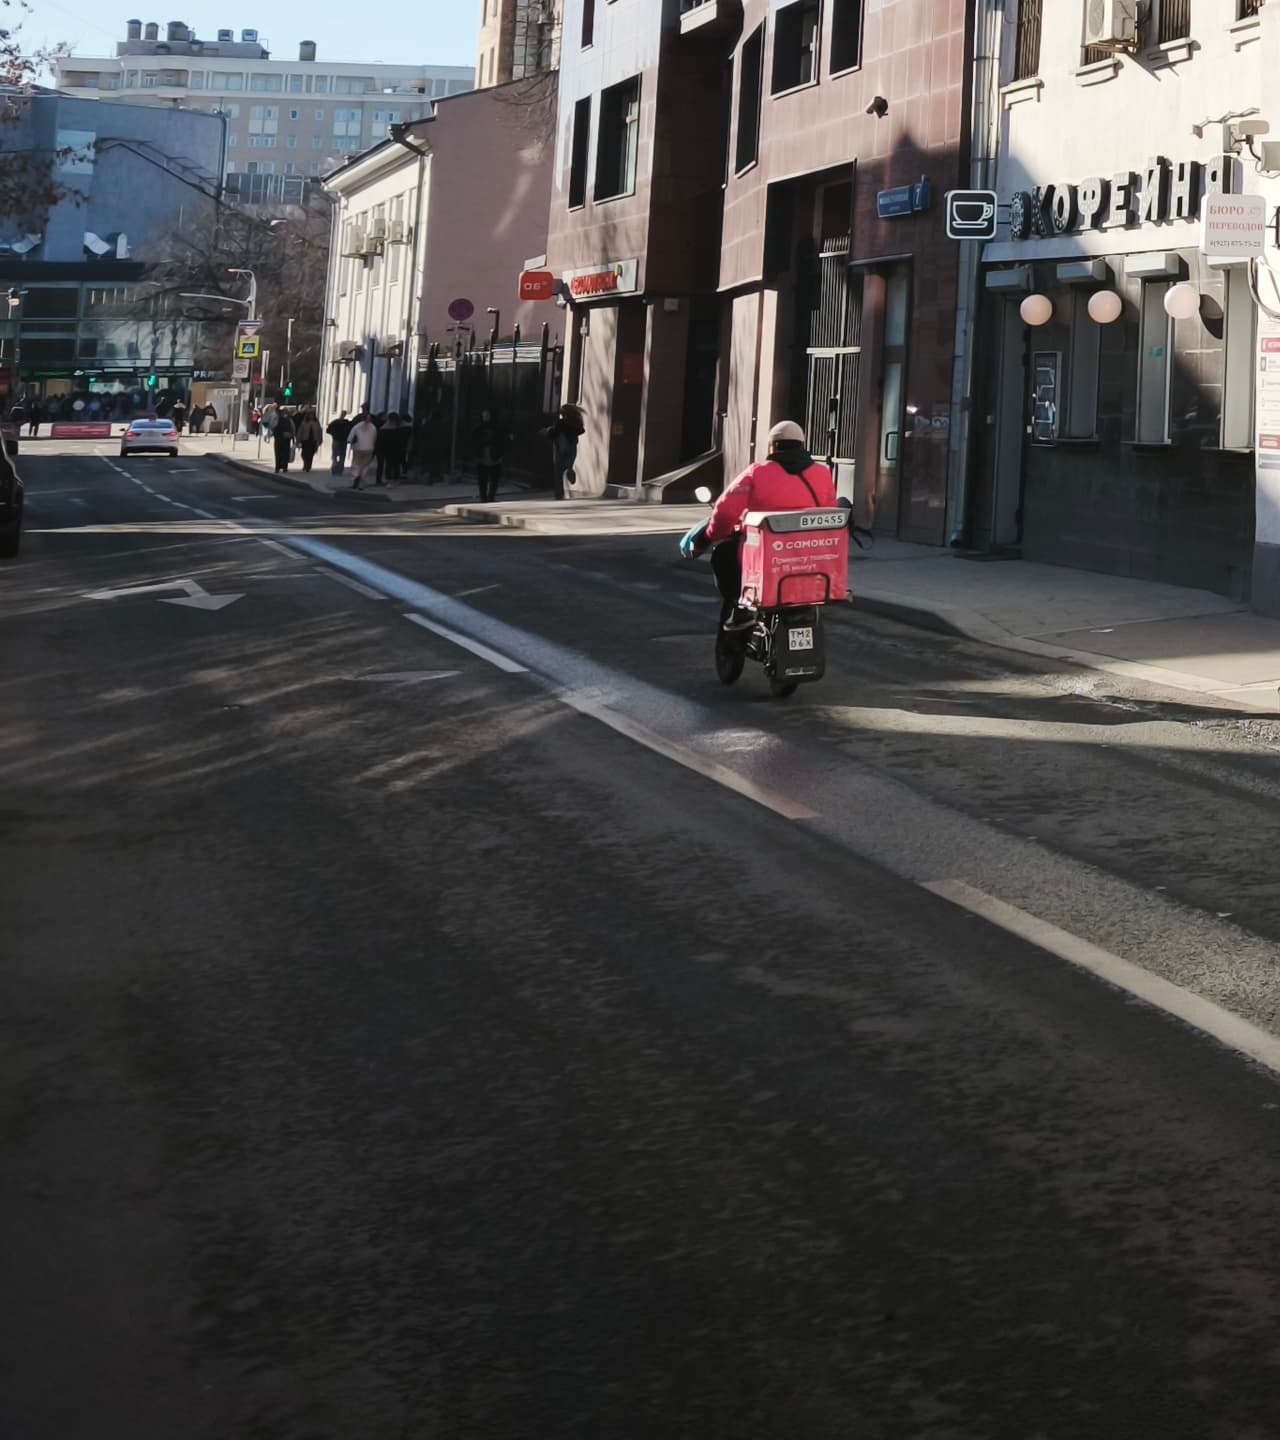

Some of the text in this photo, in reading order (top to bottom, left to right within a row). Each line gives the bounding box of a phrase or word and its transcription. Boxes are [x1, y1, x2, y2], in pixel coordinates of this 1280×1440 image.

[1031, 155, 1226, 235] КОФЕЙНЯ
[1209, 205, 1245, 216] БЮРО
[1209, 221, 1264, 233] ПЕРЕВОДОВ
[786, 537, 840, 549] самокат
